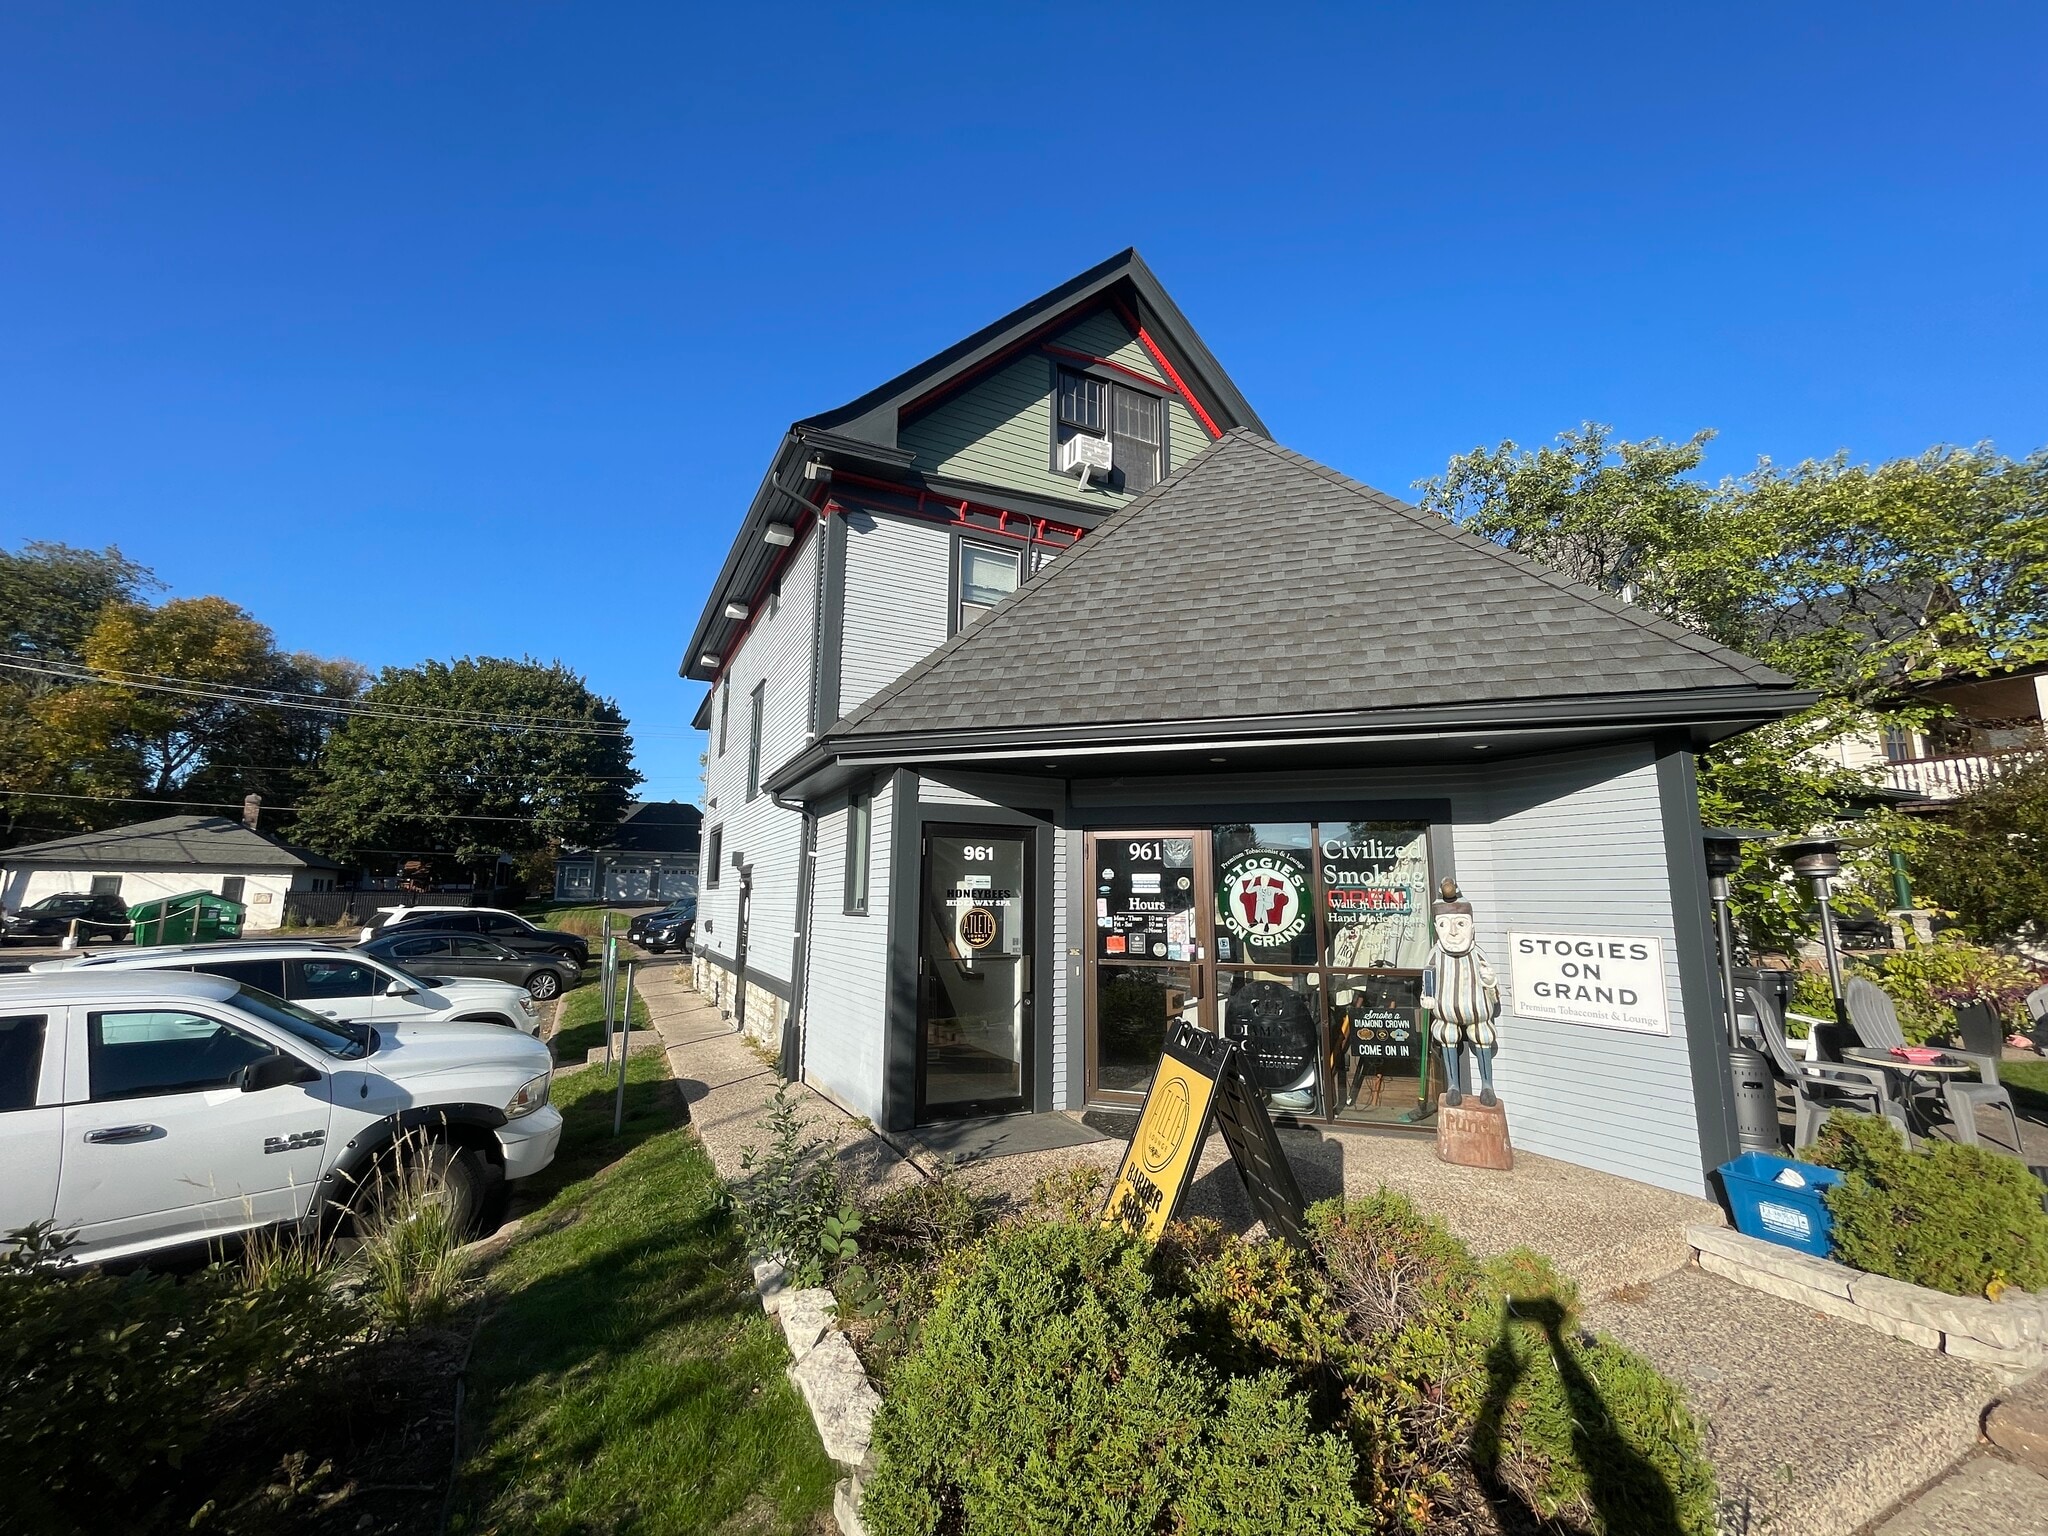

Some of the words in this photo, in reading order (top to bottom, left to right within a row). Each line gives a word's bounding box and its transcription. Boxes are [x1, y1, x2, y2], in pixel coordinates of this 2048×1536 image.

[963, 845, 994, 861] 961
[1128, 842, 1162, 861] 961
[1322, 838, 1421, 860] Civilized
[1220, 852, 1245, 870] Premium
[1279, 850, 1286, 858] &
[1224, 857, 1305, 888] STOGIES
[1323, 863, 1425, 890] Smoking
[945, 899, 995, 907] HIDEAWAY
[995, 899, 1011, 907] SPA
[946, 889, 1011, 899] HONEYBEES
[1327, 888, 1405, 911] OPEN
[1128, 897, 1166, 911] Hours
[1330, 899, 1357, 909] Walk
[962, 914, 992, 934] ATLETE
[1327, 912, 1357, 923] Hand
[1224, 916, 1248, 941] ON
[1249, 918, 1306, 947] GRAND
[1519, 939, 1649, 961] STOGIES
[1561, 962, 1602, 981] ON
[1533, 981, 1638, 1006] GRAND
[1354, 1019, 1384, 1029] DIAMOND
[1385, 1019, 1411, 1029] CROWN
[1363, 1009, 1393, 1020] Smoke
[1520, 1002, 1557, 1014] Premium
[1558, 1005, 1609, 1020] Tobacconist
[1611, 1012, 1621, 1021] &
[1623, 1012, 1659, 1027] Lounge
[1359, 1044, 1382, 1056] COME
[1385, 1045, 1397, 1057] ON
[1400, 1045, 1410, 1057] IN
[1125, 1161, 1164, 1214] BARBER
